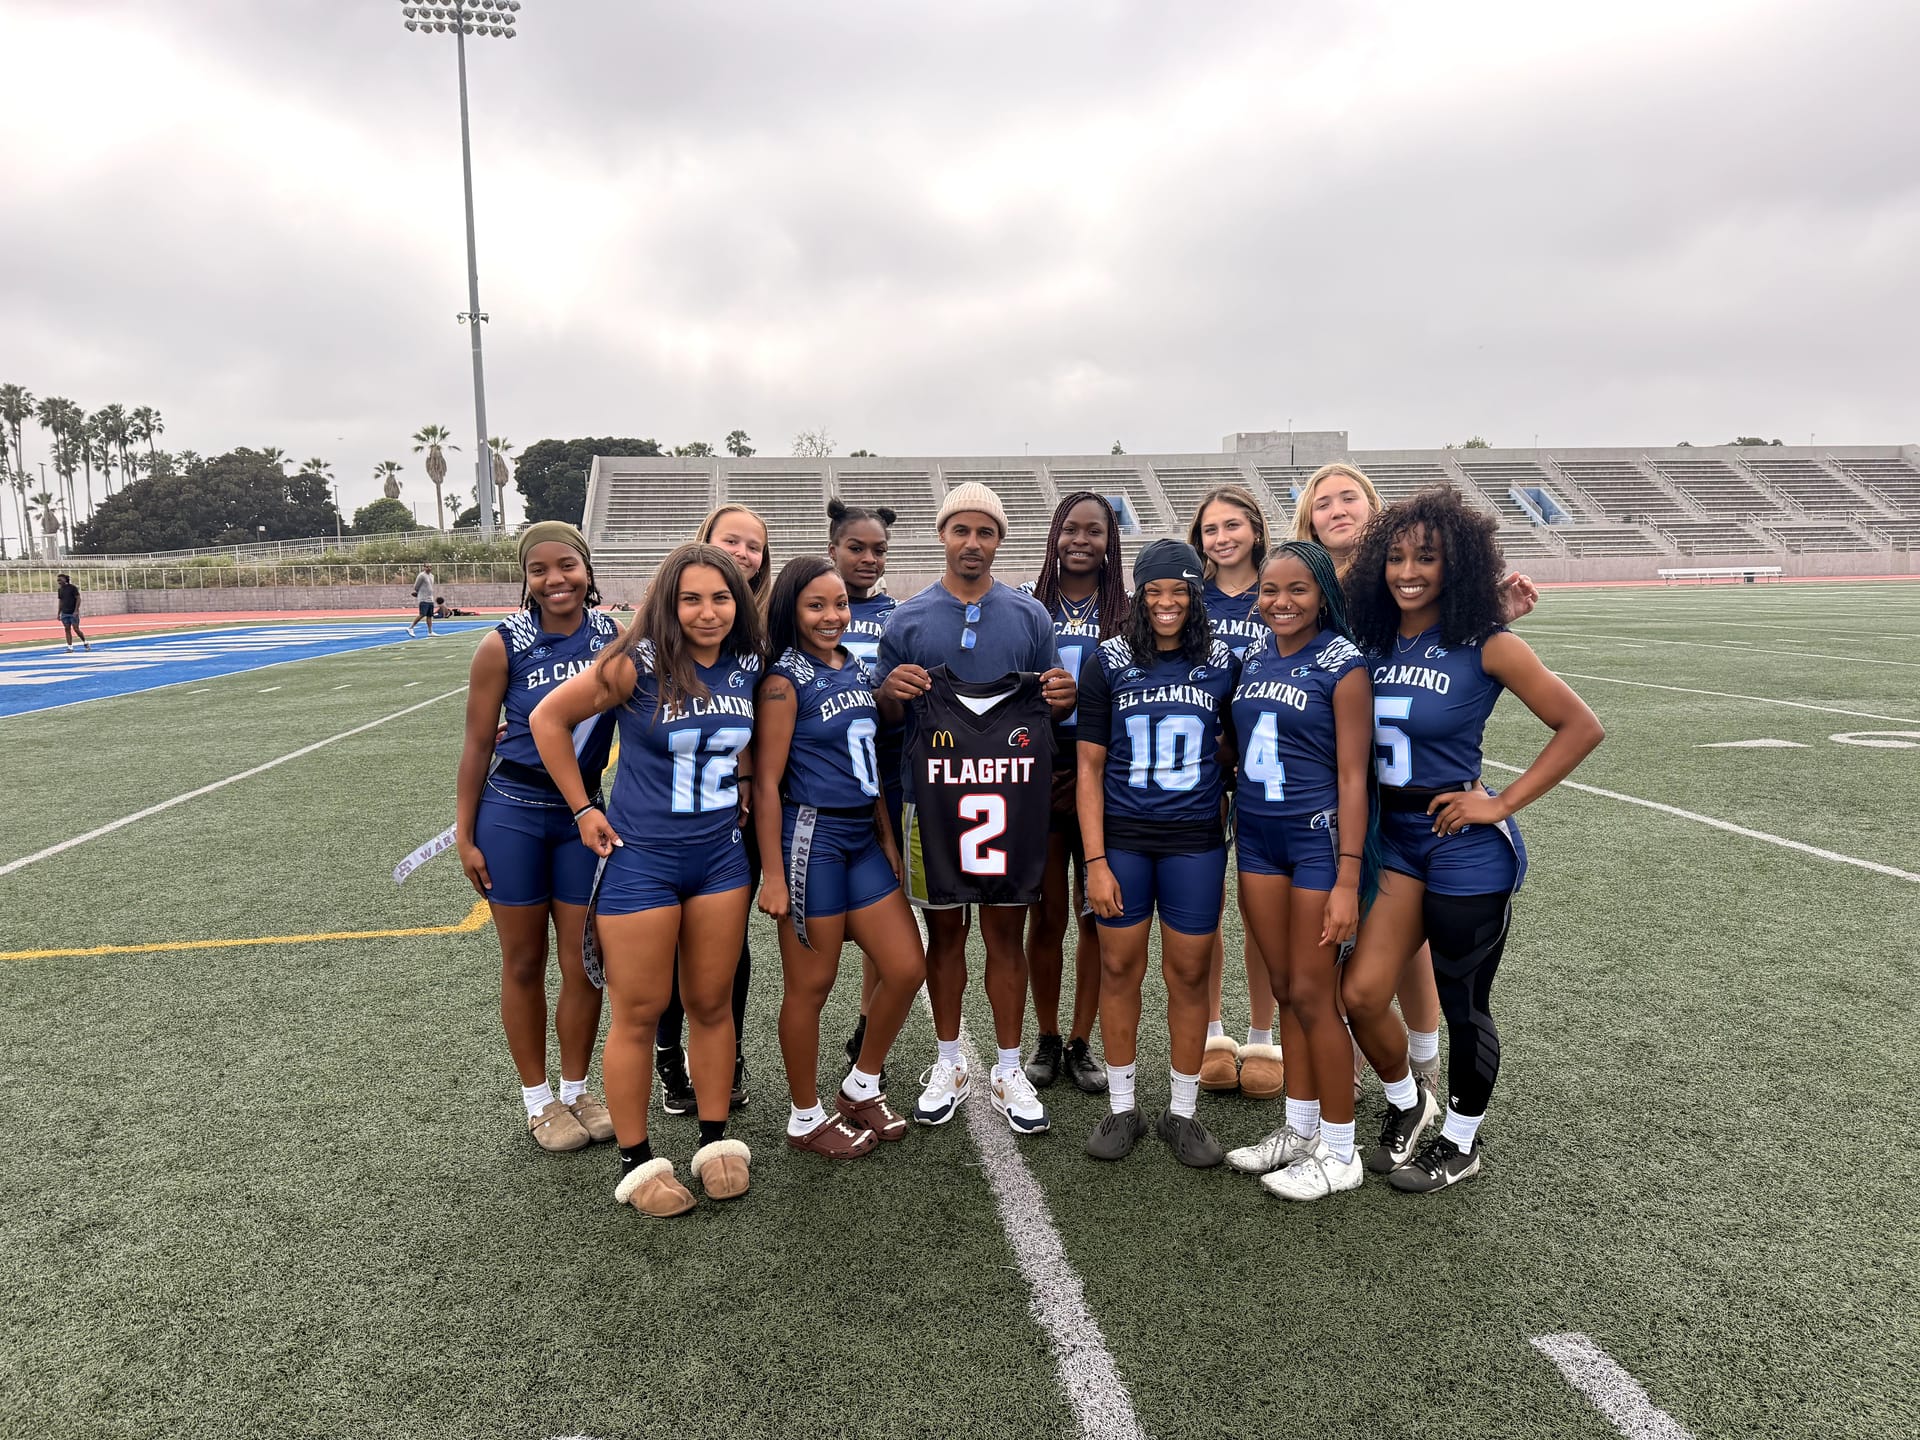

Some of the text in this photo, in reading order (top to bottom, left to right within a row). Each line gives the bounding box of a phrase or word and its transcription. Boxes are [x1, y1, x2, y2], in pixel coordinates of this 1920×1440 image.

[527, 661, 596, 690] EL CAM
[1374, 664, 1451, 695] CAMINO
[820, 698, 841, 722] EL
[1118, 684, 1214, 712] EL CAMINO
[1245, 681, 1308, 711] CAMINO
[662, 700, 690, 724] EL
[847, 718, 880, 797] 0
[1125, 714, 1206, 791] 10
[1244, 711, 1287, 801] 4
[1374, 696, 1414, 788] 5
[668, 728, 753, 813] 12
[927, 757, 1035, 784] FLAGFIT
[420, 830, 457, 860] WAR
[958, 792, 1008, 876] 2
[794, 836, 810, 925] WARRIORS
